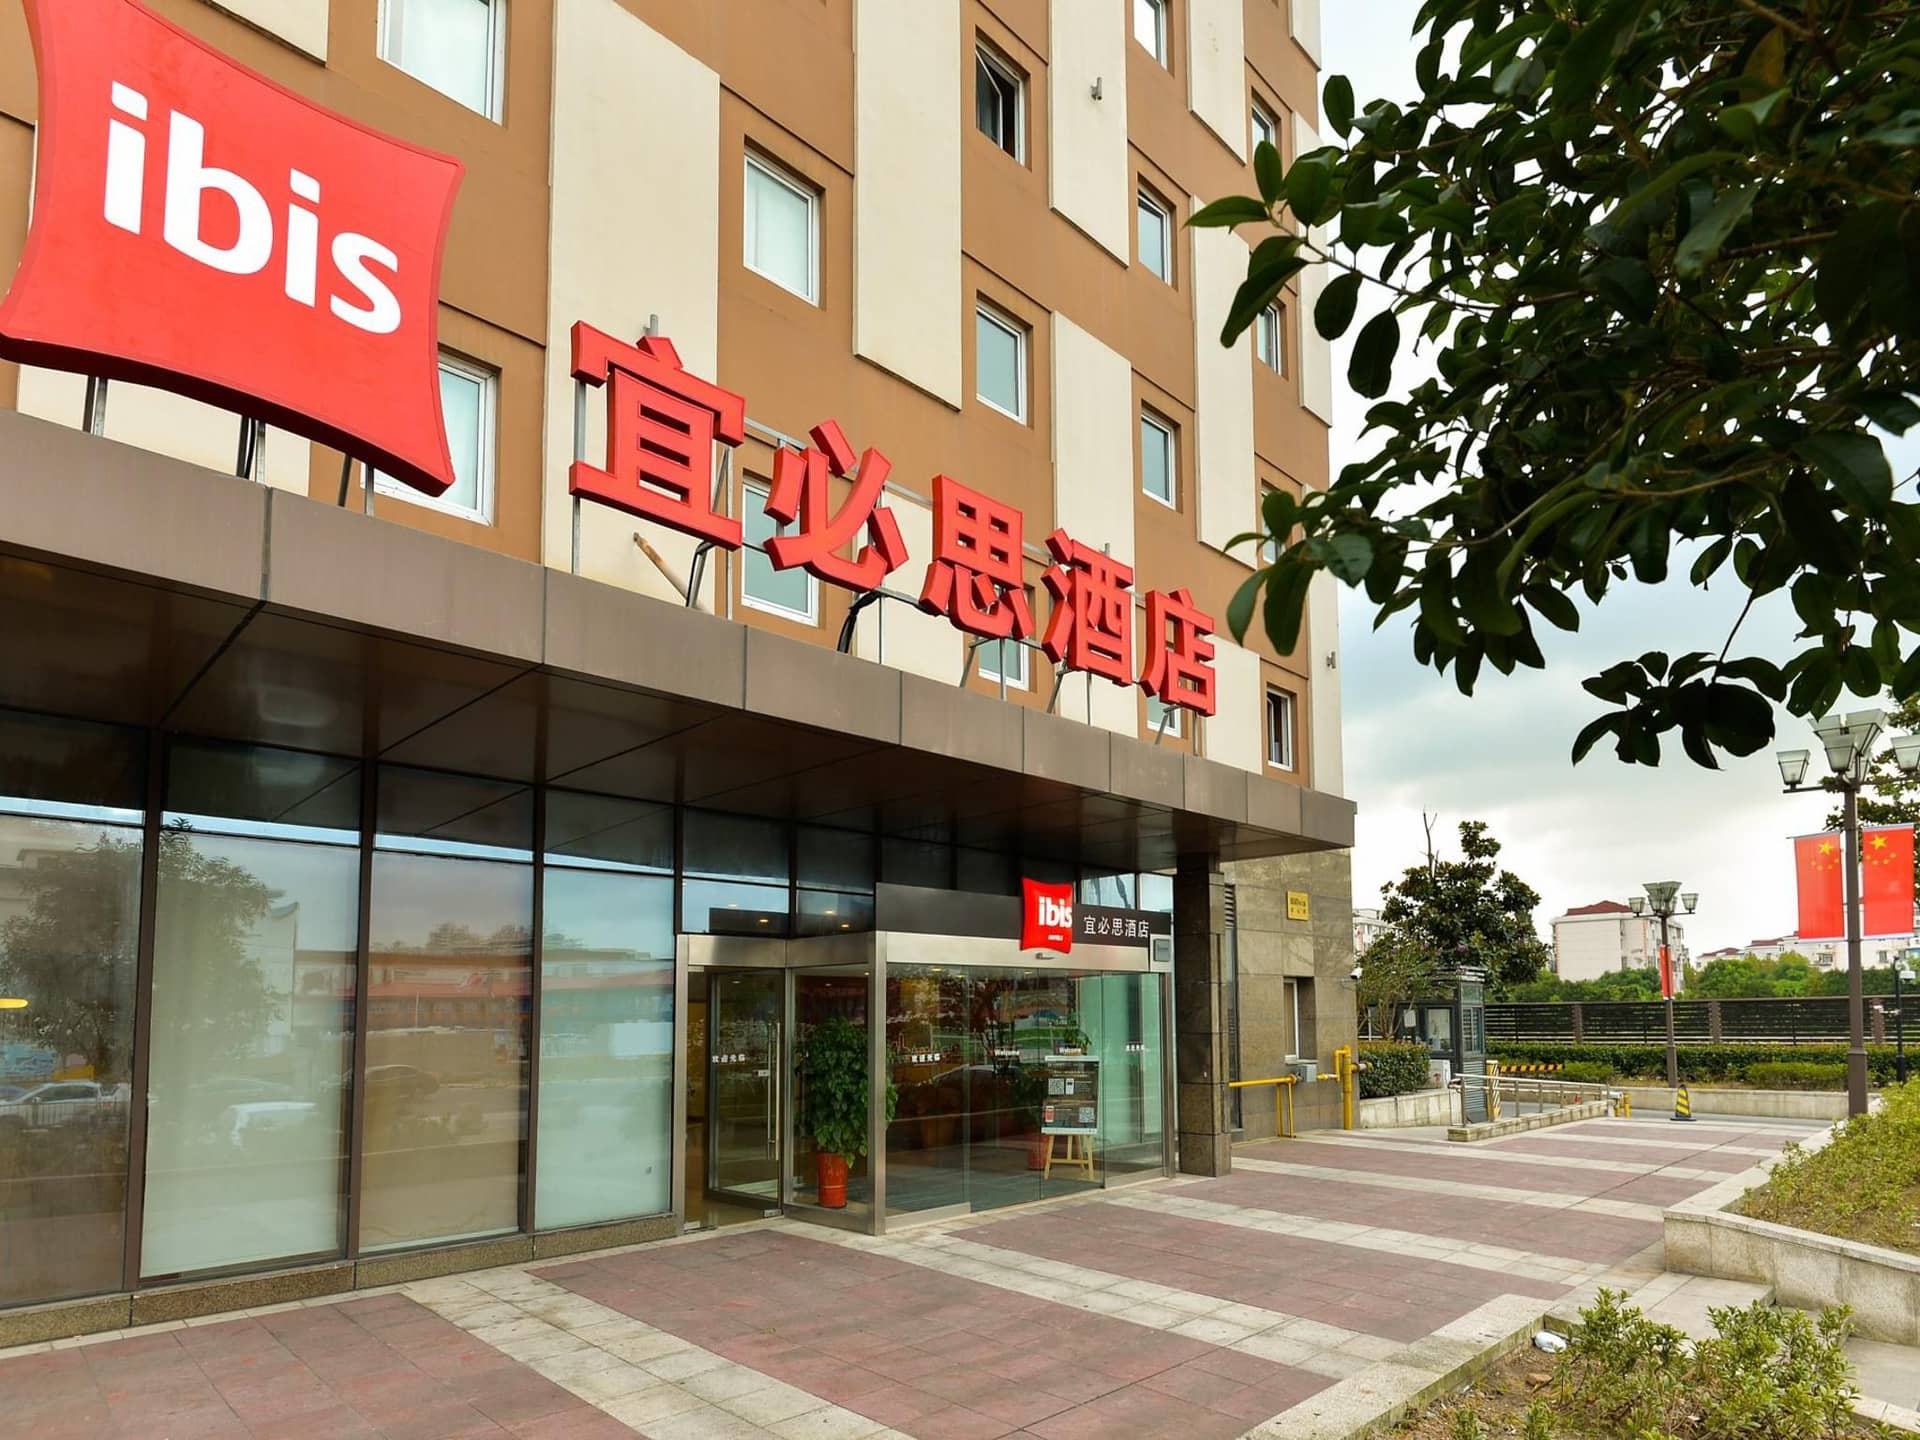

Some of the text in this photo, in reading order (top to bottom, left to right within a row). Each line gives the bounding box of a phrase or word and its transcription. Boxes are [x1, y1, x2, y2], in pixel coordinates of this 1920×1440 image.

[104, 80, 401, 334] ibis
[569, 320, 1216, 716] 宜必思酒店
[1038, 896, 1072, 928] ibis
[1083, 915, 1149, 938] 宜必思酒店
